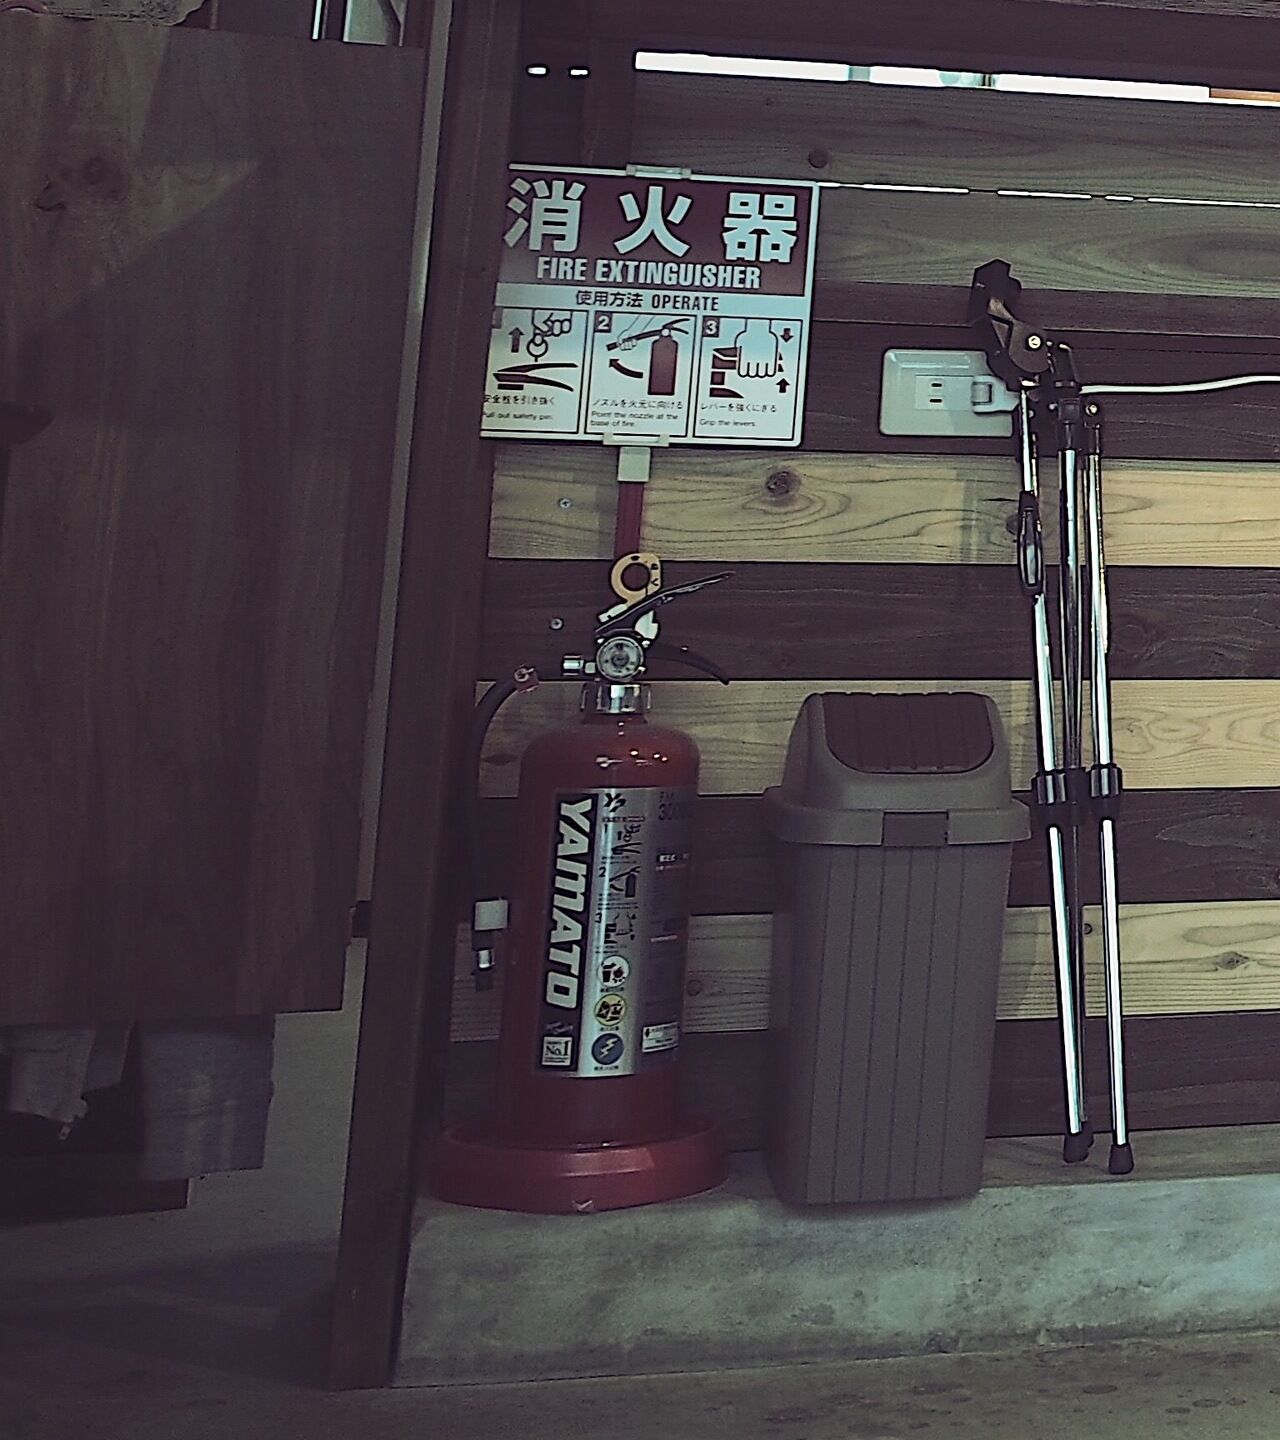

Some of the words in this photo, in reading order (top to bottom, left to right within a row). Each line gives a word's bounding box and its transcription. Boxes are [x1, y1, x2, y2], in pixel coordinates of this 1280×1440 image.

[503, 176, 799, 264] 消火器
[536, 256, 588, 281] FIRE
[594, 260, 762, 289] EXTINGUISHER
[575, 290, 644, 308] 使用方法
[651, 293, 720, 311] OPERATE
[598, 316, 610, 330] 2
[706, 321, 718, 335] 3
[546, 797, 593, 1010] YAMATO
